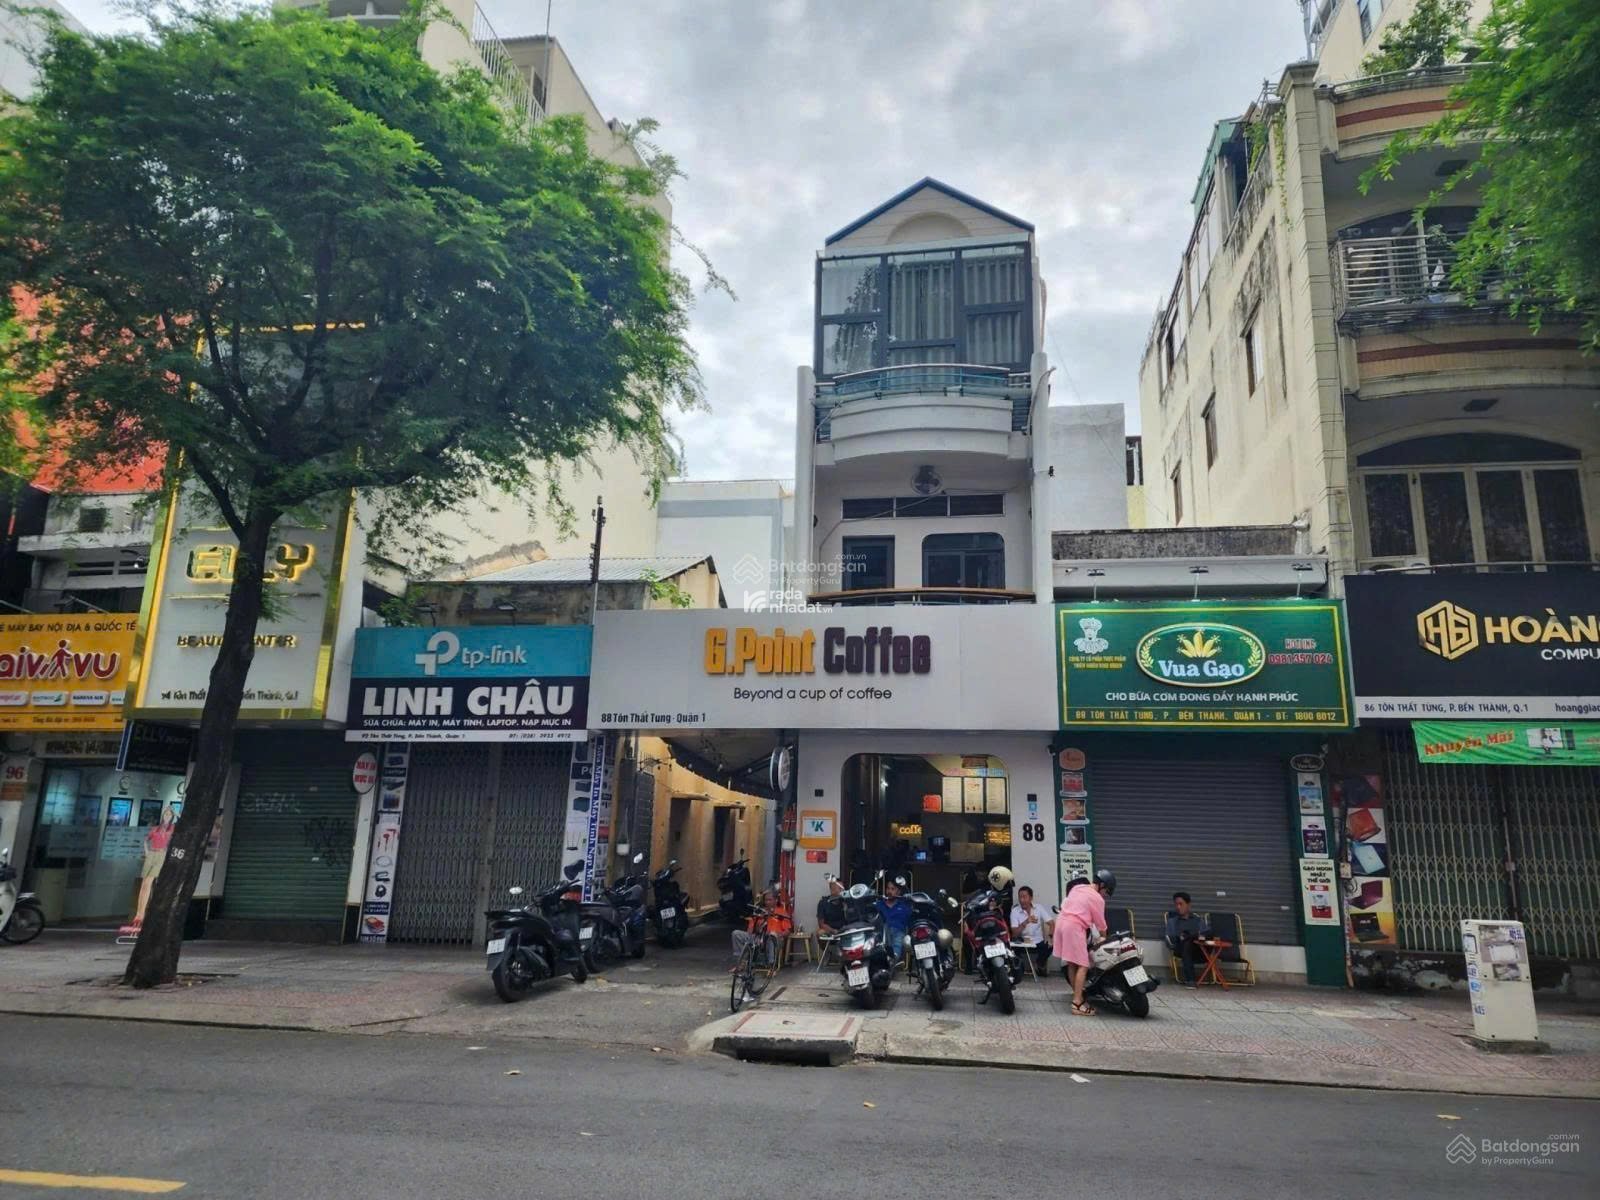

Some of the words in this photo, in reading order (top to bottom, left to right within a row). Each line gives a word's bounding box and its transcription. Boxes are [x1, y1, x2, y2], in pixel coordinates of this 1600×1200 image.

[1484, 608, 1600, 643] HOÀN
[462, 645, 527, 668] tp-link
[706, 627, 817, 675] G.Point
[824, 627, 931, 674] Coffee
[1158, 660, 1200, 677] Vua
[1203, 660, 1245, 679] Gạo
[363, 687, 453, 716] LINH
[467, 678, 574, 716] CHÂU
[734, 688, 783, 701] Beyond
[786, 689, 796, 699] a
[799, 690, 826, 701] cup
[830, 688, 844, 699] of
[847, 688, 892, 699] coffee
[1105, 692, 1127, 701] CHO
[1129, 691, 1151, 701] BỮA
[1236, 693, 1267, 702] HẠNH
[1269, 691, 1298, 701] PHÚC
[1364, 704, 1374, 712] 86
[1378, 702, 1395, 712] TÔN
[561, 718, 572, 727] IN
[601, 713, 612, 723] 88
[702, 713, 706, 722] 1
[6, 767, 24, 780] 96
[1023, 823, 1045, 842] 88
[170, 847, 185, 859] 36
